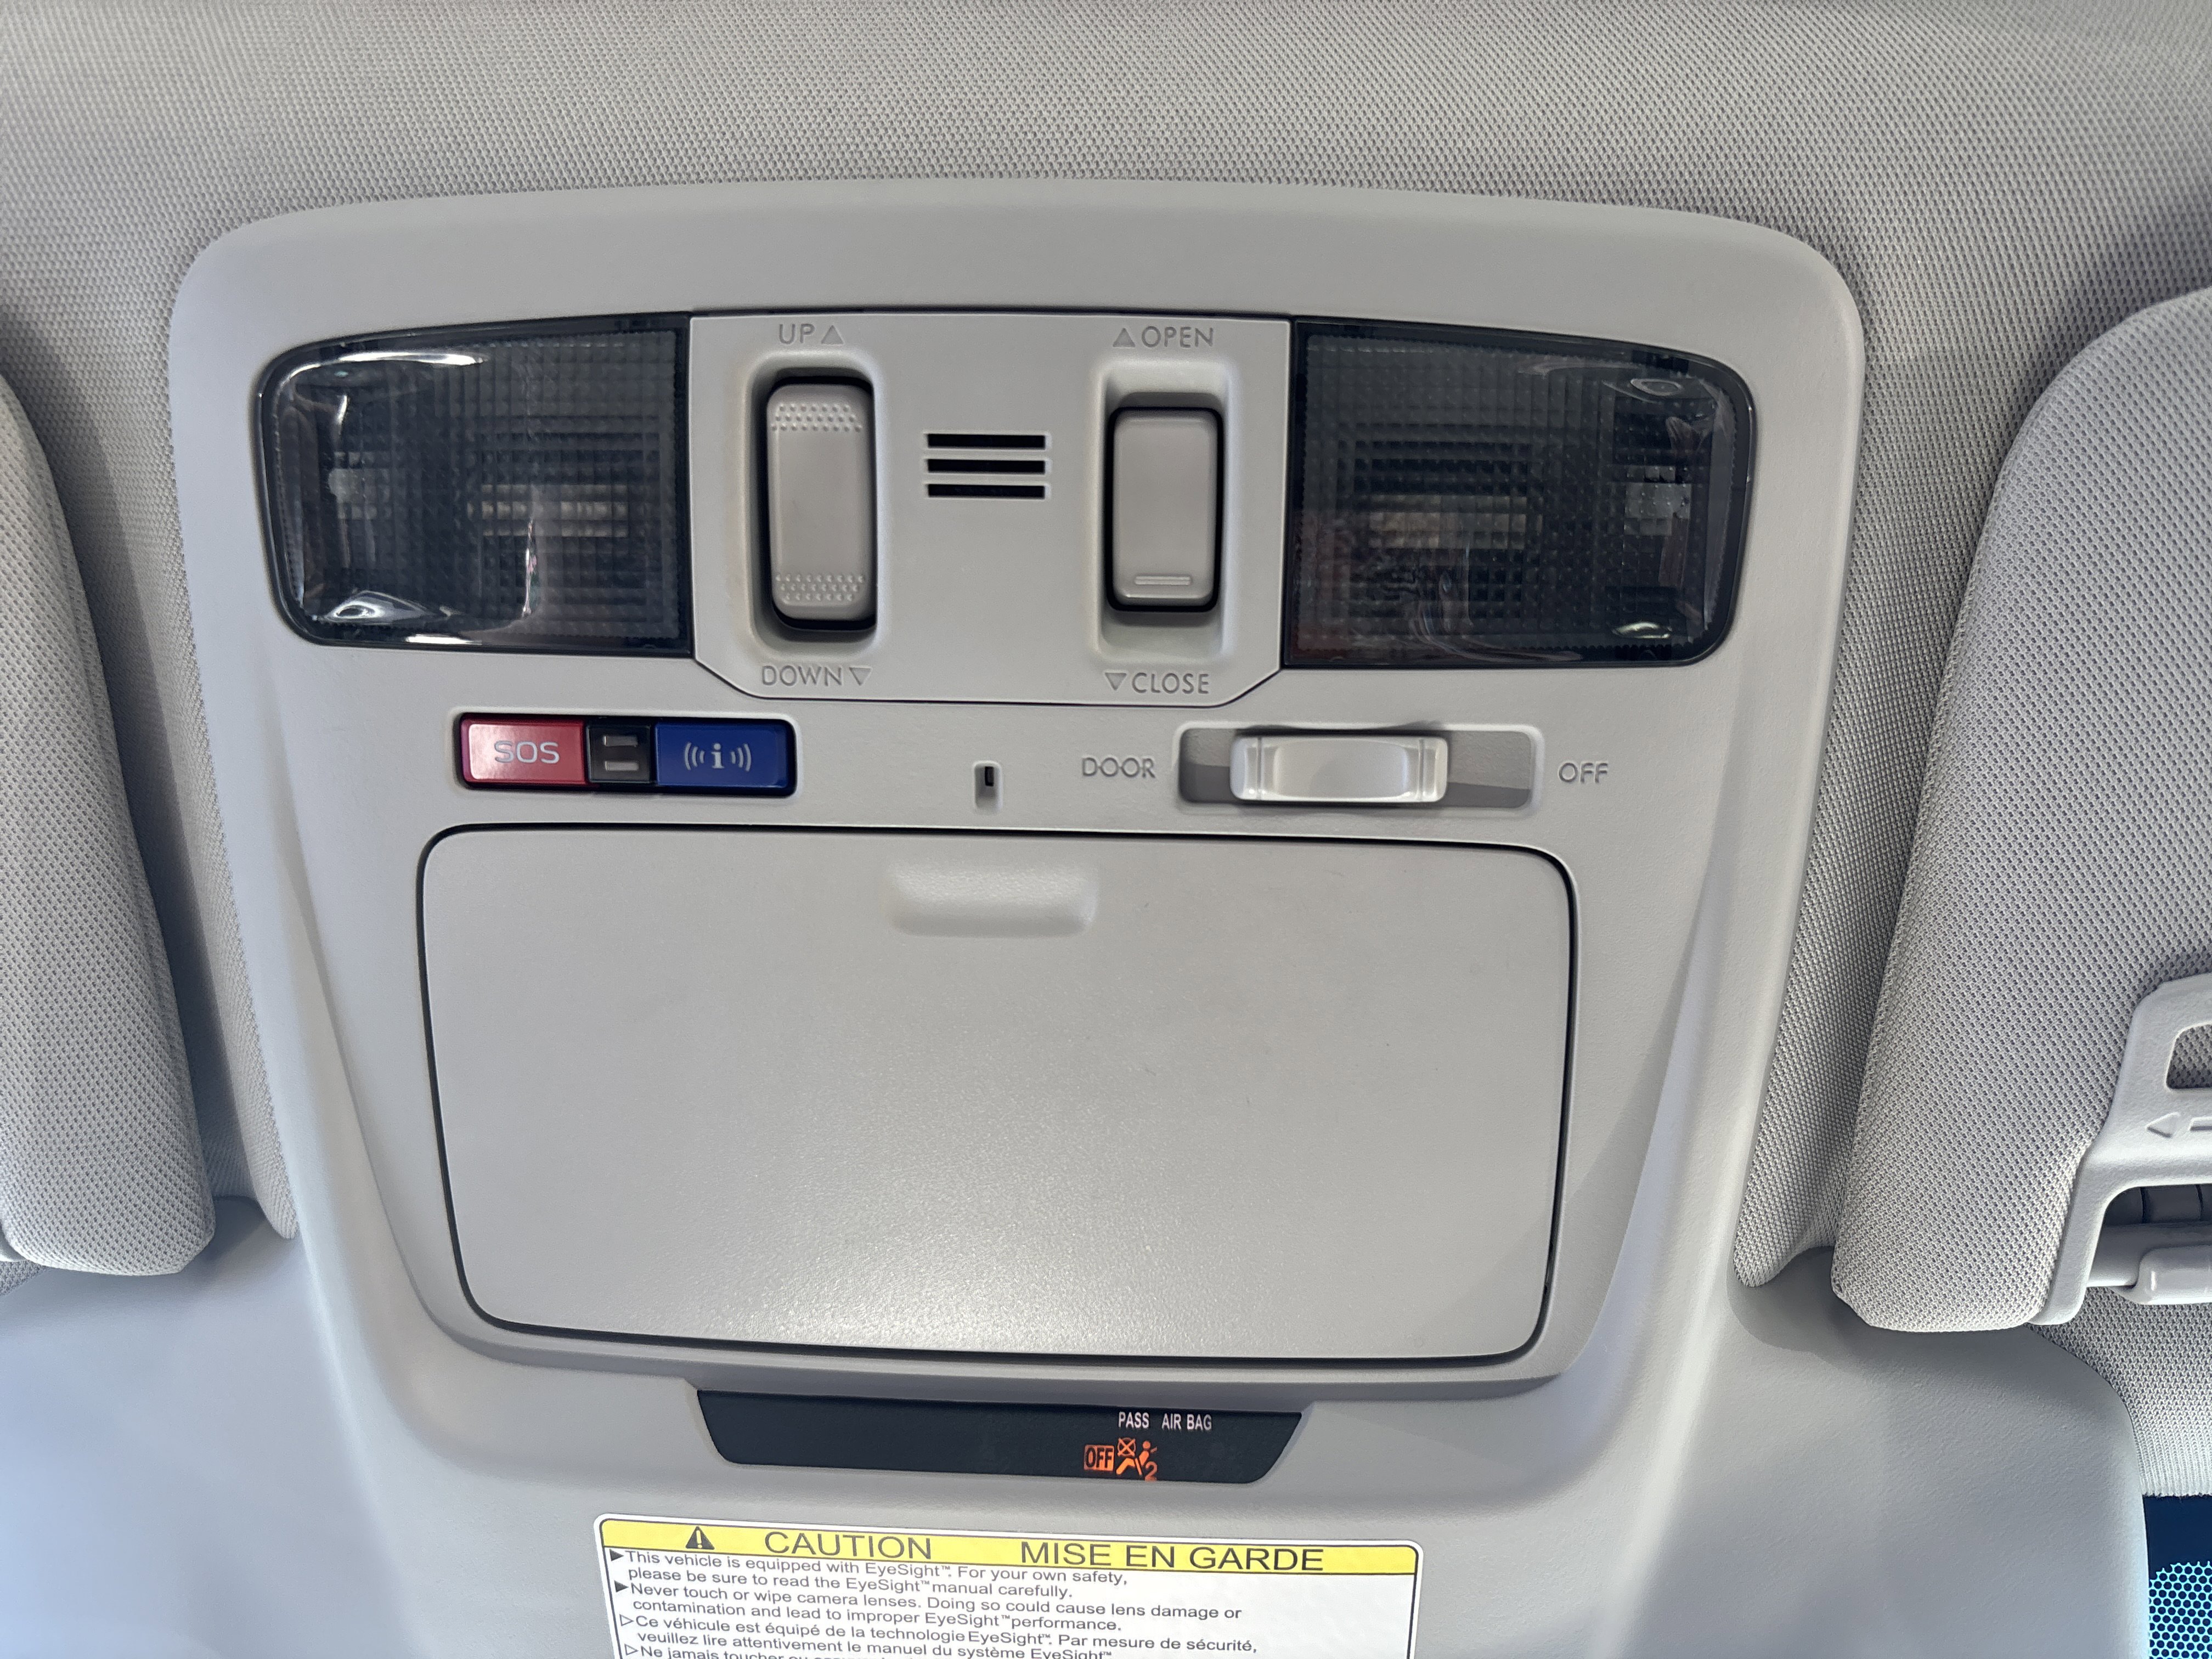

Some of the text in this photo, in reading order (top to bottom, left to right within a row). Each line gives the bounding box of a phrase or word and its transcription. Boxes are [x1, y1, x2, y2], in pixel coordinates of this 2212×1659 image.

[778, 323, 815, 345] UP
[1141, 325, 1214, 348] OPEN
[762, 665, 842, 686] DOWN
[1132, 672, 1209, 695] CLOSE
[494, 740, 560, 764] SOS
[1082, 757, 1156, 778] DOOR
[1558, 762, 1608, 783] OFF
[1118, 1412, 1212, 1431] PASS AIR BAG
[1084, 1447, 1113, 1469] OFF
[765, 1532, 931, 1559] CAUTION
[1022, 1542, 1324, 1571] MISE EN GARDE
[625, 1550, 660, 1563] This
[665, 1554, 721, 1567] vehicle
[727, 1556, 740, 1568] is
[746, 1559, 821, 1573] equipped
[826, 1561, 859, 1573] with
[958, 1566, 986, 1578] For
[991, 1570, 1028, 1581] your
[1033, 1572, 1066, 1581] own
[1073, 1571, 1127, 1585] safety,
[629, 1567, 681, 1581] please
[687, 1570, 707, 1582] be
[712, 1575, 747, 1584] sure
[752, 1574, 768, 1585] to
[774, 1576, 809, 1587] read
[815, 1577, 840, 1588] the
[933, 1583, 992, 1594] manual
[998, 1585, 1072, 1600] carefully.
[631, 1583, 1242, 1620] Never touch or wipe camera lenses. Doing so could cause lens damage or
[633, 1601, 745, 1615] contamination
[752, 1606, 781, 1617] and
[787, 1607, 820, 1619] lead
[826, 1609, 841, 1620] to
[847, 1609, 919, 1625] improper
[1012, 1617, 1121, 1630] performance.
[636, 1616, 658, 1627] Ce
[663, 1618, 730, 1632] véhicule
[736, 1623, 760, 1633] est
[765, 1623, 820, 1638] équipé
[826, 1626, 845, 1637] de
[851, 1627, 865, 1637] la
[870, 1628, 965, 1643] technologie
[1059, 1634, 1088, 1646] Par
[1093, 1638, 1154, 1648] mesure
[1160, 1638, 1181, 1649] de
[1187, 1639, 1256, 1653] sécurité,
[637, 1633, 698, 1644] veuillez
[703, 1634, 727, 1646] lire
[733, 1637, 843, 1651] attentivement
[848, 1641, 861, 1652] le
[867, 1644, 926, 1655] manuel
[933, 1645, 951, 1656] du
[958, 1647, 1025, 1659] système
[641, 1646, 663, 1657] Ne
[668, 1647, 719, 1659] jamais
